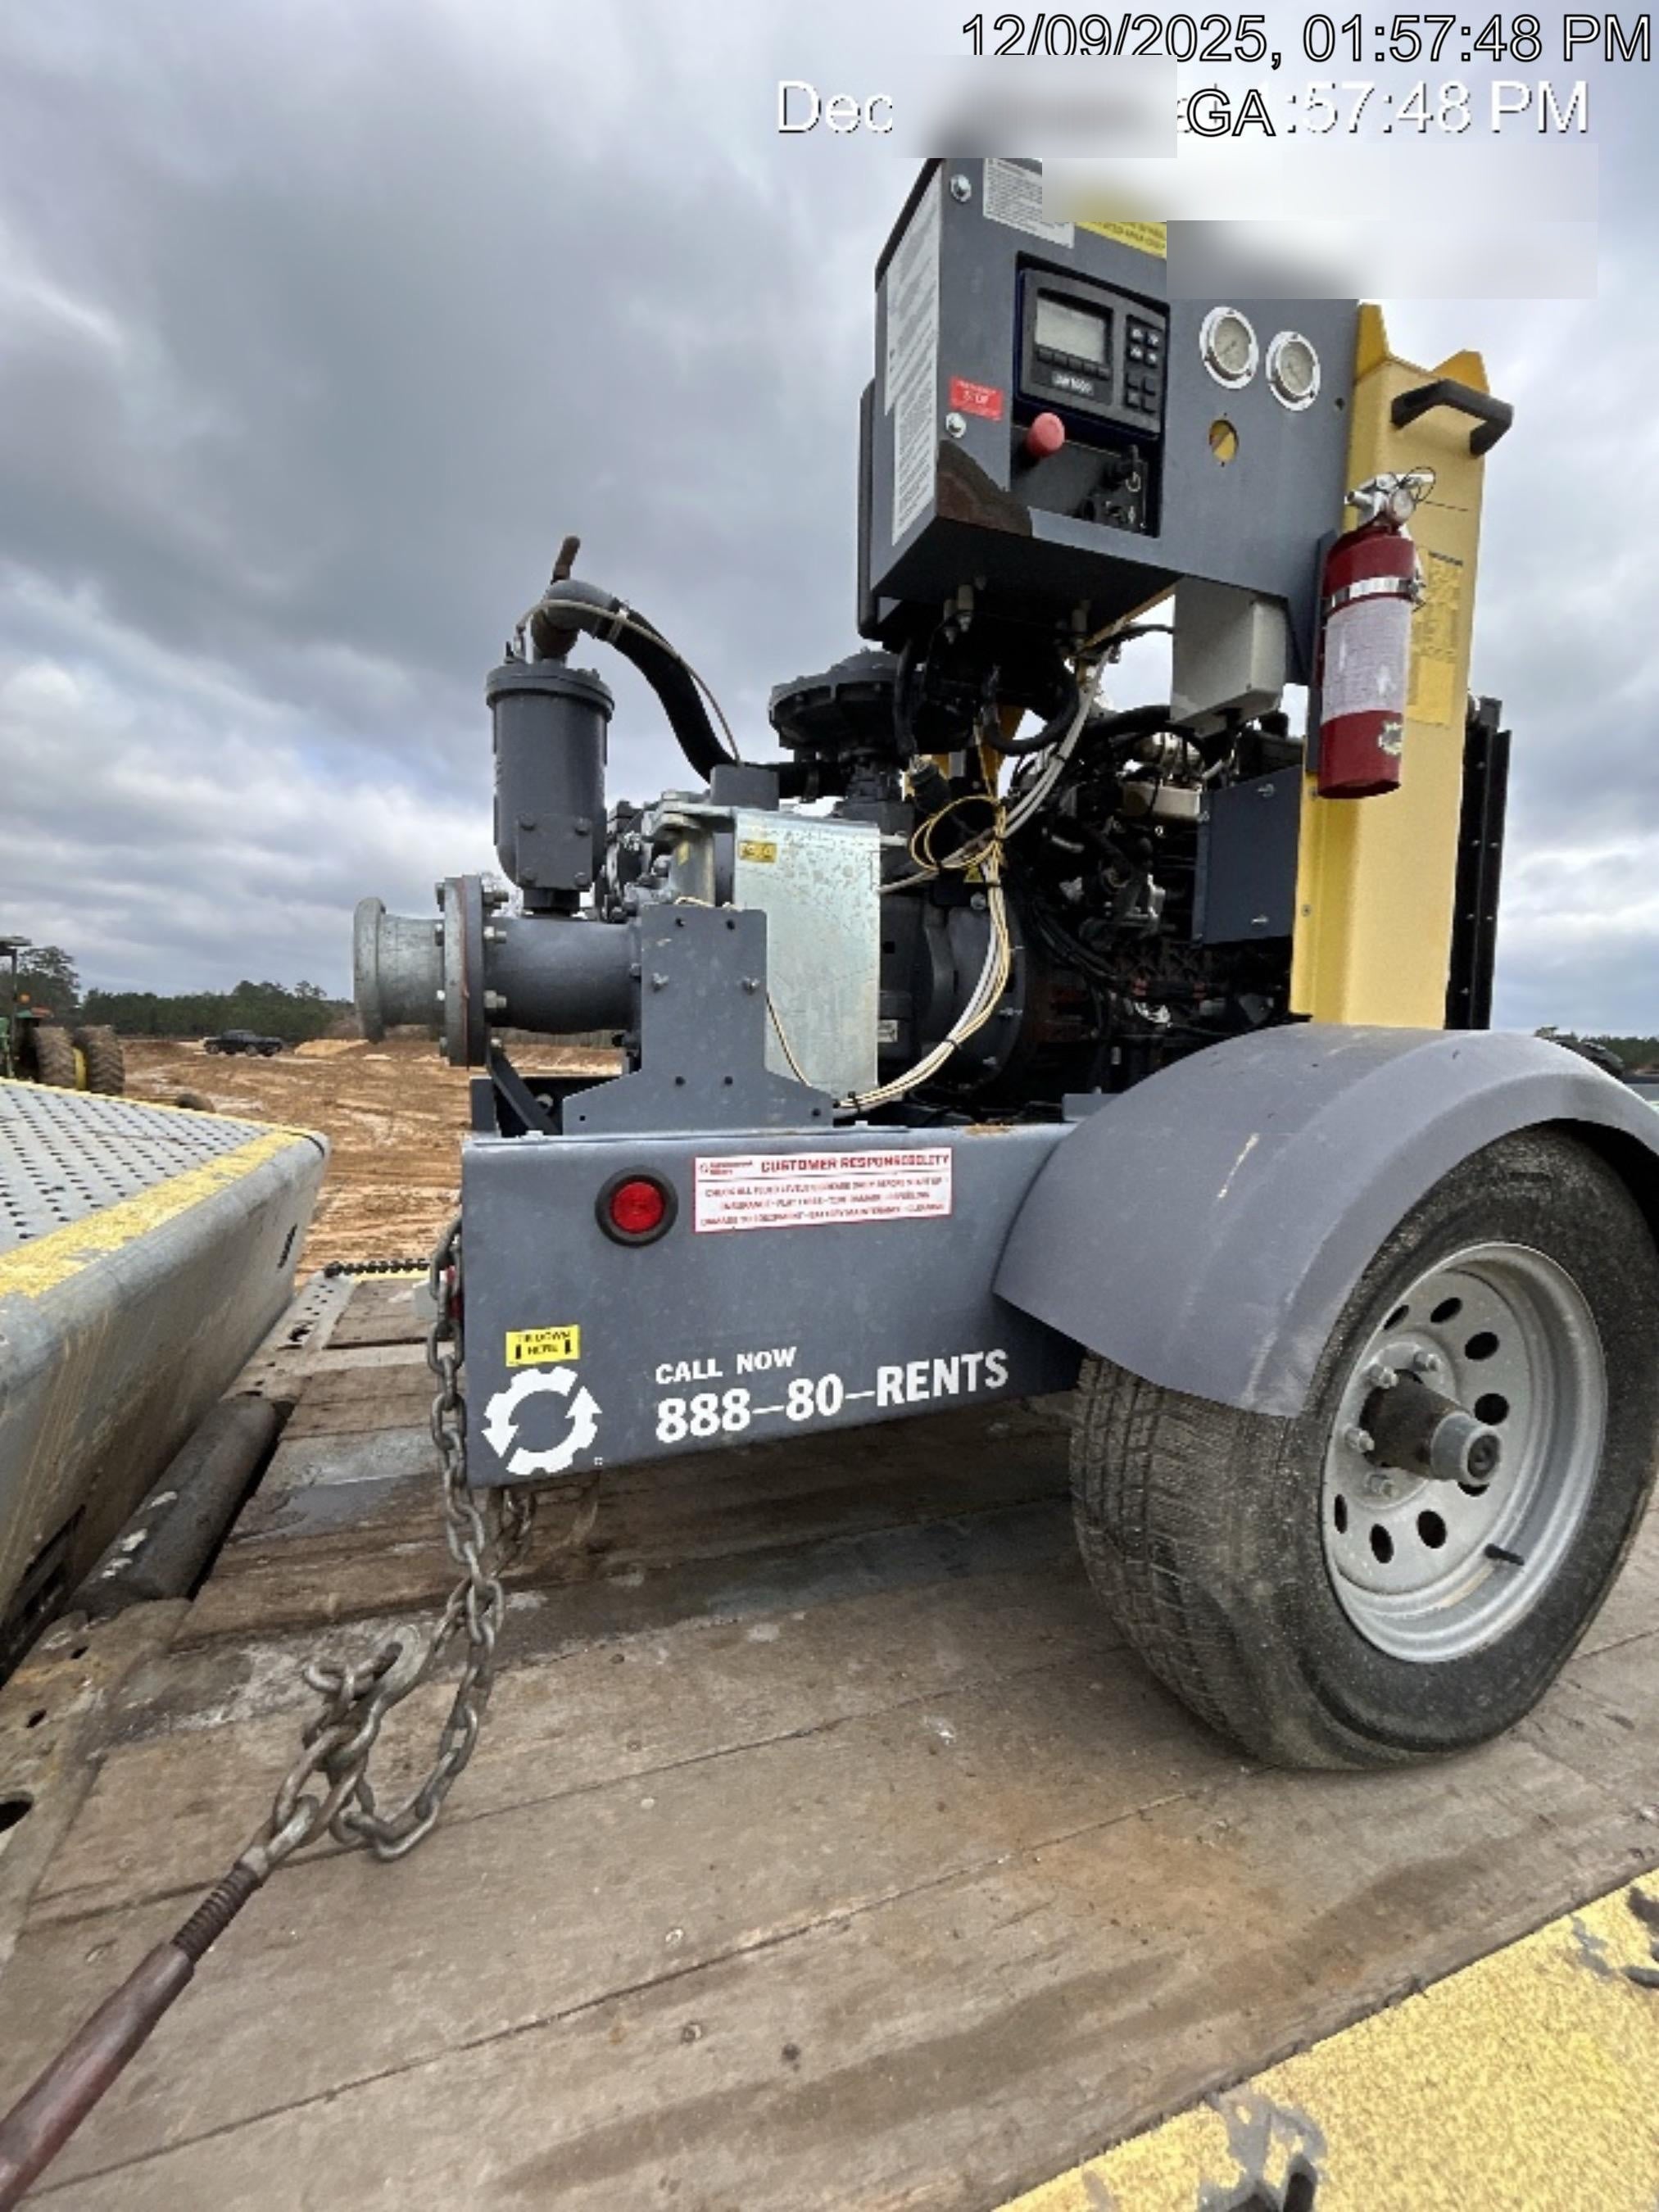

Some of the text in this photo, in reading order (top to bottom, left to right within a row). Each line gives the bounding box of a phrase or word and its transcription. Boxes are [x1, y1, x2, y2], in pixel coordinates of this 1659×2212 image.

[761, 1158, 837, 1173] CUSTOMER
[841, 1154, 950, 1169] RESPONSIBILITY
[655, 1346, 797, 1385] CALL NOW
[655, 1349, 1009, 1444] 888-80-RENTS
